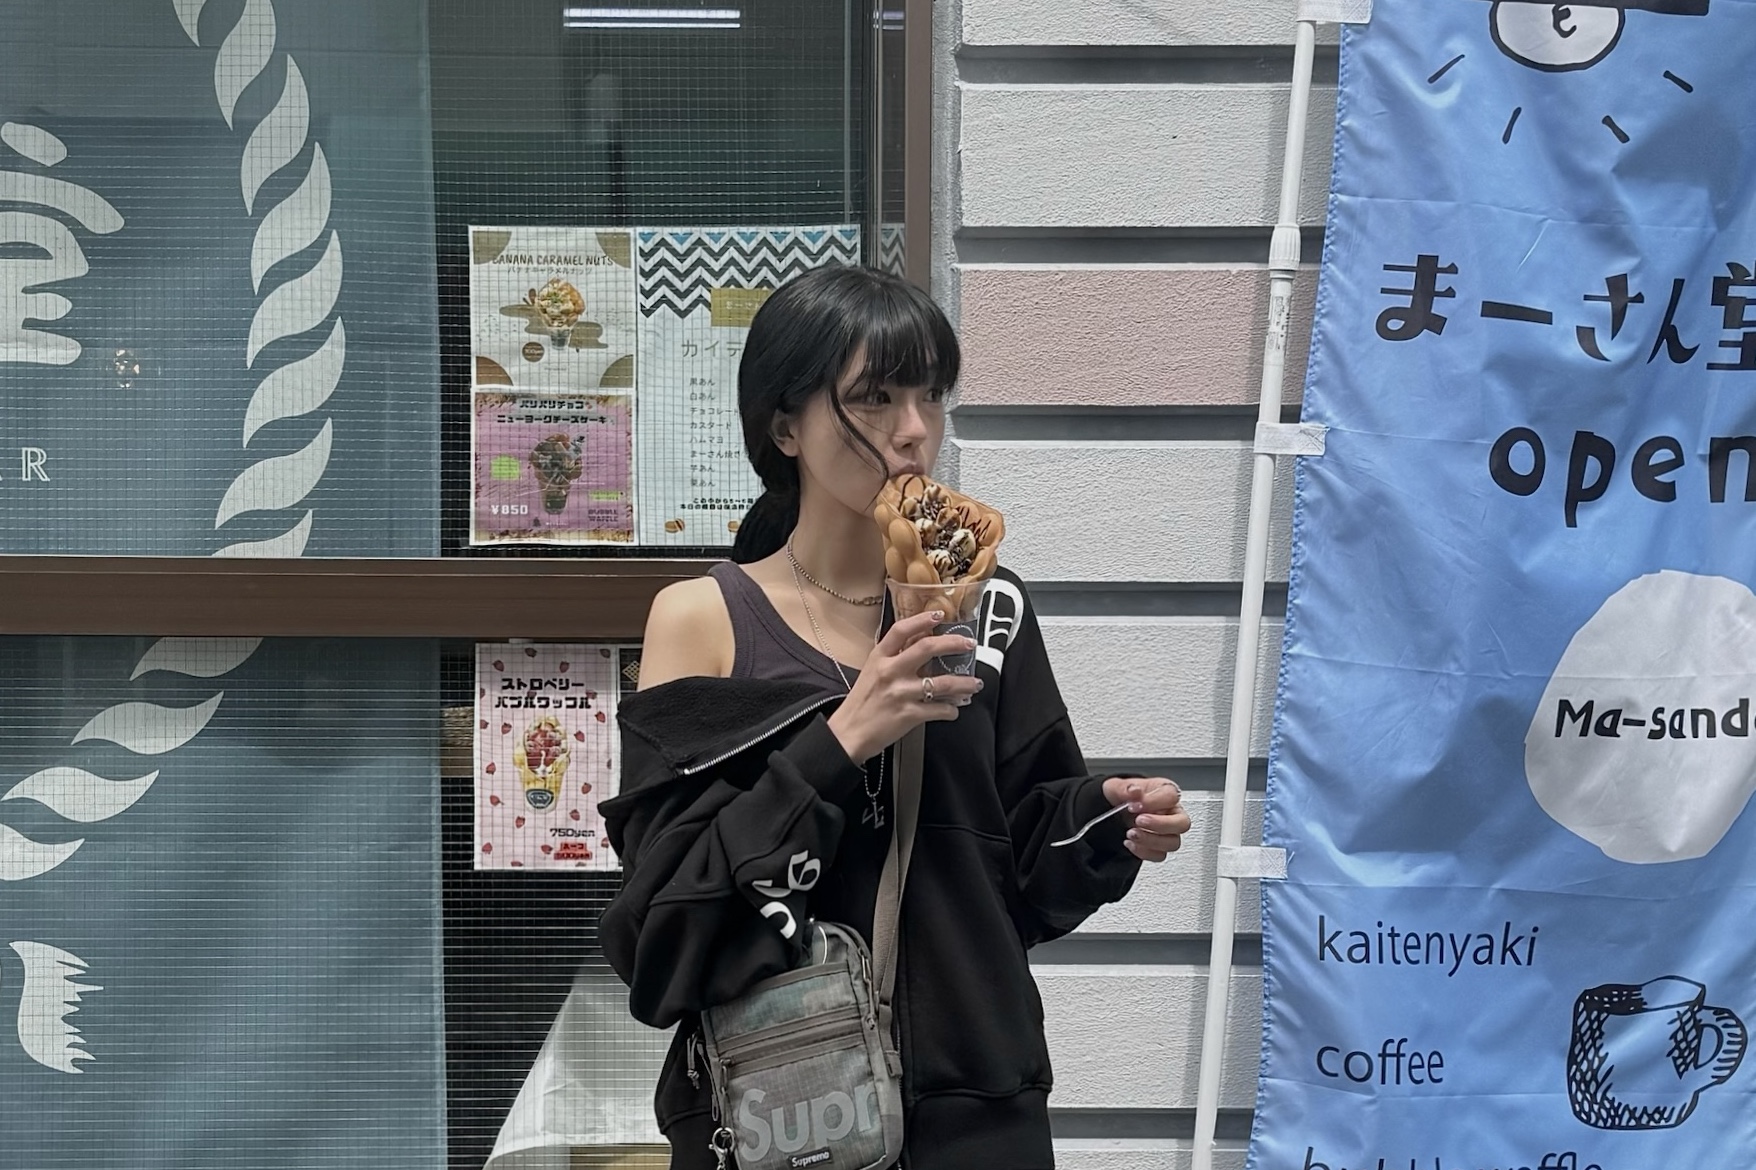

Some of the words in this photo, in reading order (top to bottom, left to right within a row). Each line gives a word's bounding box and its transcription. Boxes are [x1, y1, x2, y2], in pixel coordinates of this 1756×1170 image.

[537, 254, 583, 266] CARAMEL
[586, 255, 613, 266] NUTS
[497, 415, 606, 424] ニューヨークチーズケーキ
[1489, 426, 1756, 528] open
[491, 504, 528, 515] ¥850
[501, 678, 584, 690] ストロベリー
[495, 696, 591, 709] バブルワッフル
[1555, 698, 1756, 740] Ma-sand
[549, 828, 595, 837] 750yen
[1318, 915, 1538, 977] kaitenyaki
[1316, 1037, 1445, 1085] coffee
[791, 1151, 830, 1167] Supreme
